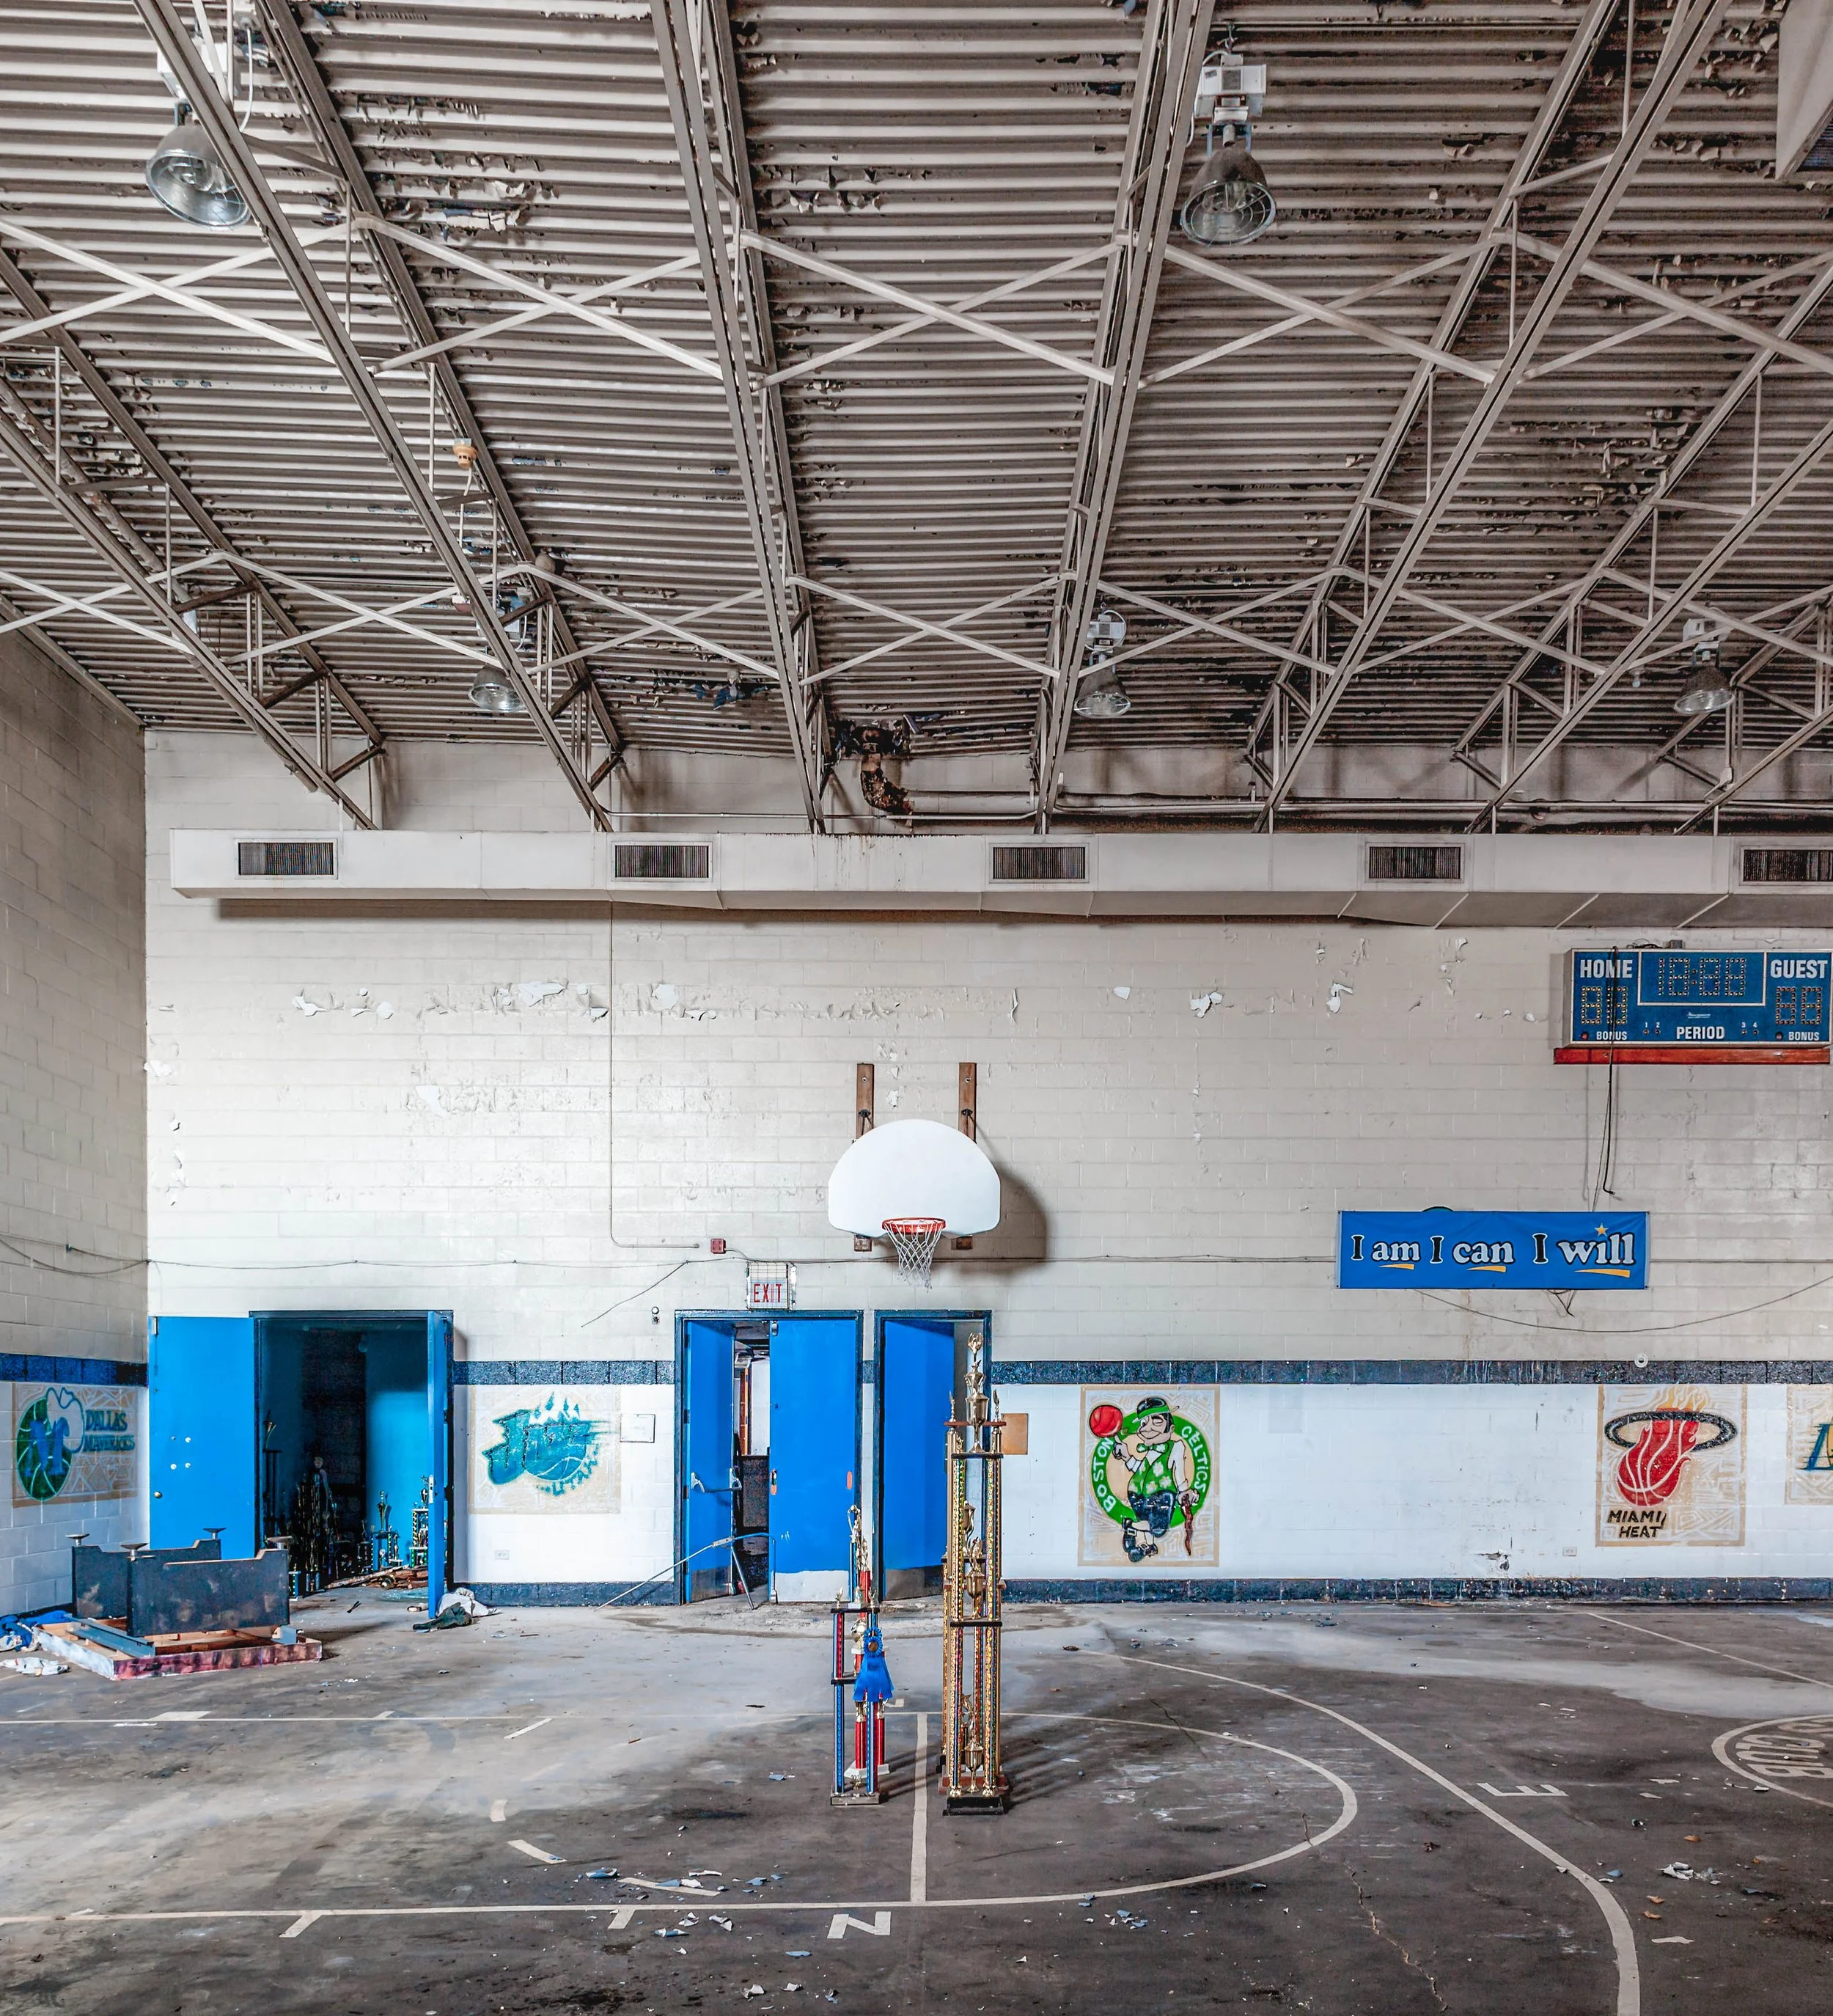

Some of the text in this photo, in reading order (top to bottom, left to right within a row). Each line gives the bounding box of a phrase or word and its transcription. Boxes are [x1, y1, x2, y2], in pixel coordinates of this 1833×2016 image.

[1580, 959, 1634, 978] HOME
[1770, 959, 1828, 978] GUEST
[1596, 1031, 1628, 1041] BONUS
[1676, 1026, 1724, 1040] PERIOD
[1788, 1032, 1820, 1041] BONUS
[1351, 1228, 1636, 1265] I am I can I will
[754, 1283, 782, 1303] EXIT
[85, 1410, 128, 1432] DALLAS
[1092, 1437, 1116, 1512] BOSTON
[1607, 1509, 1662, 1523] MIAMI
[1619, 1523, 1664, 1539] HEAT
